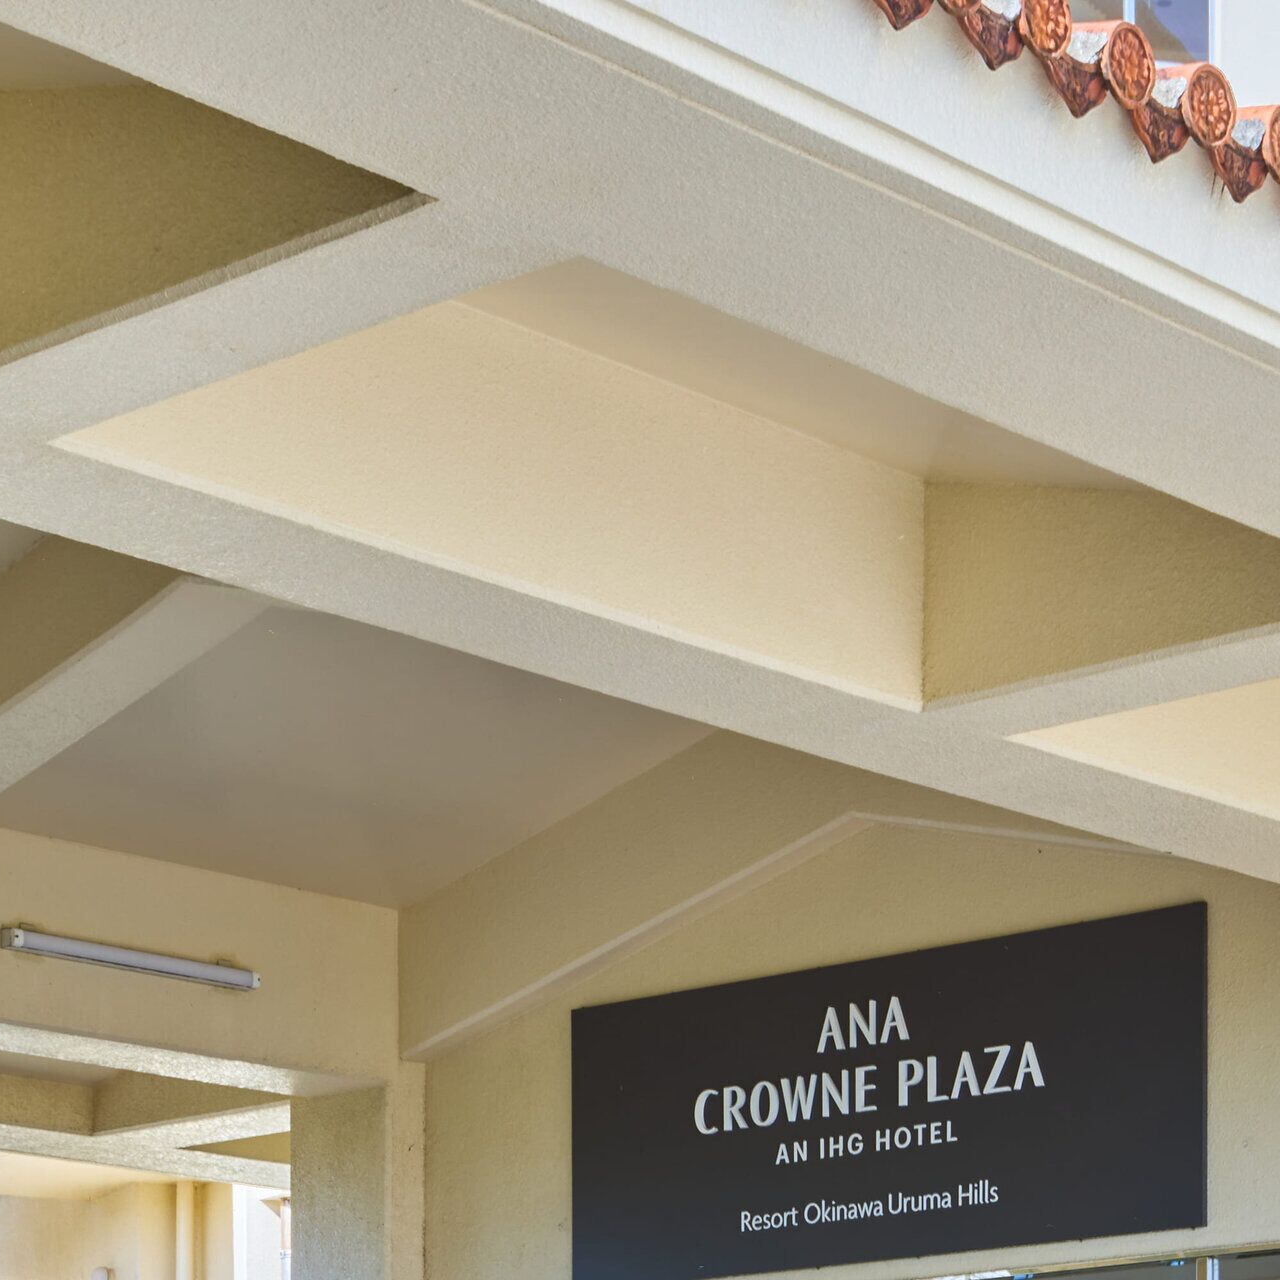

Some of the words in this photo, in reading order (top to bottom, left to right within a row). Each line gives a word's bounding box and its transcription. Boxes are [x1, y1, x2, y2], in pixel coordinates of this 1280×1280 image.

[816, 995, 911, 1054] ANA
[693, 1064, 878, 1135] CROWNE
[898, 1040, 1046, 1107] PLAZA
[775, 1140, 809, 1166] AN
[819, 1132, 865, 1160] IHG
[875, 1120, 959, 1152] HOTEL
[740, 1206, 799, 1233] Resort
[803, 1199, 885, 1226] Okinawa
[888, 1191, 953, 1216] Uruma
[958, 1179, 1000, 1207] Hills
